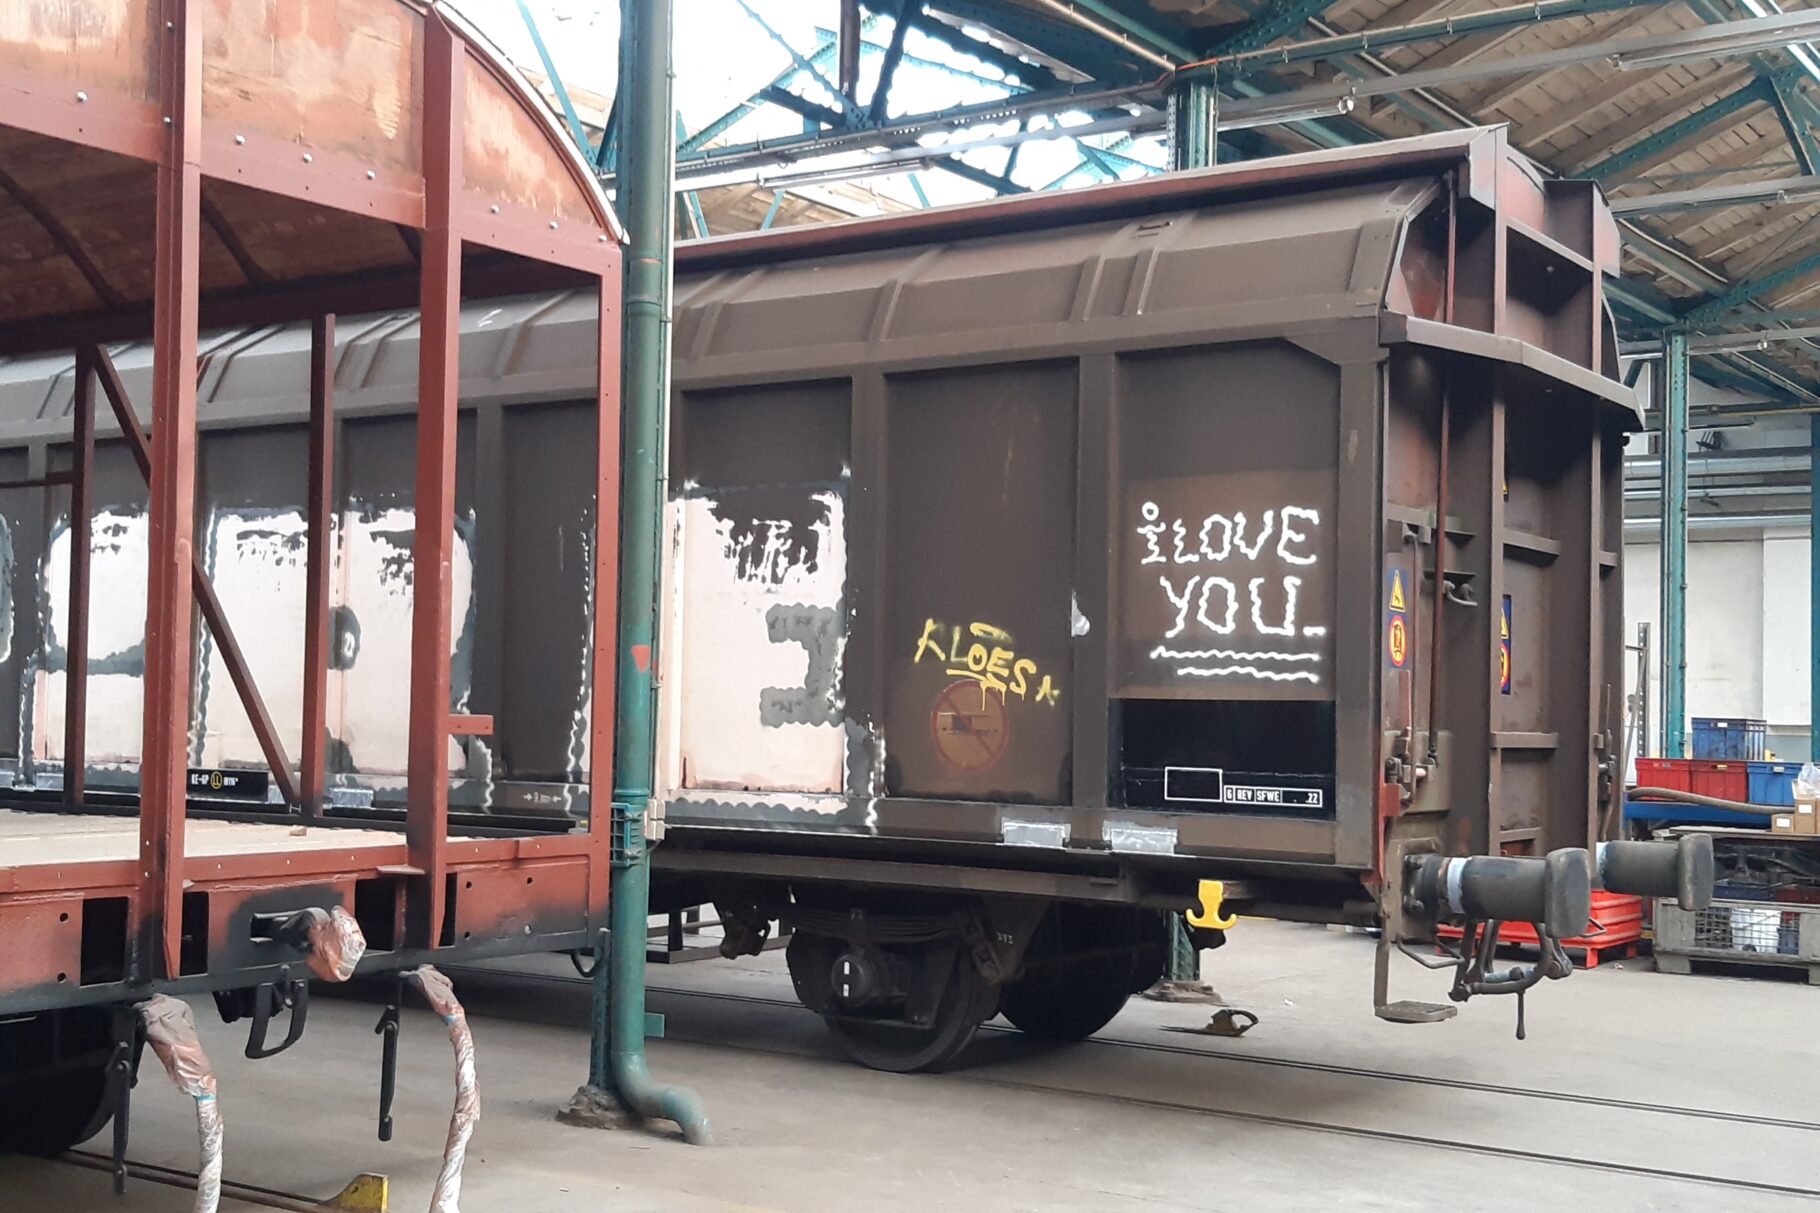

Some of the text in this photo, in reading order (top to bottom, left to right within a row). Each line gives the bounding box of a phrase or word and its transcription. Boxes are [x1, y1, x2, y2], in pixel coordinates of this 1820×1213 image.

[1226, 788, 1232, 800] 6
[1237, 789, 1252, 800] REV
[1256, 790, 1280, 802] SFWE
